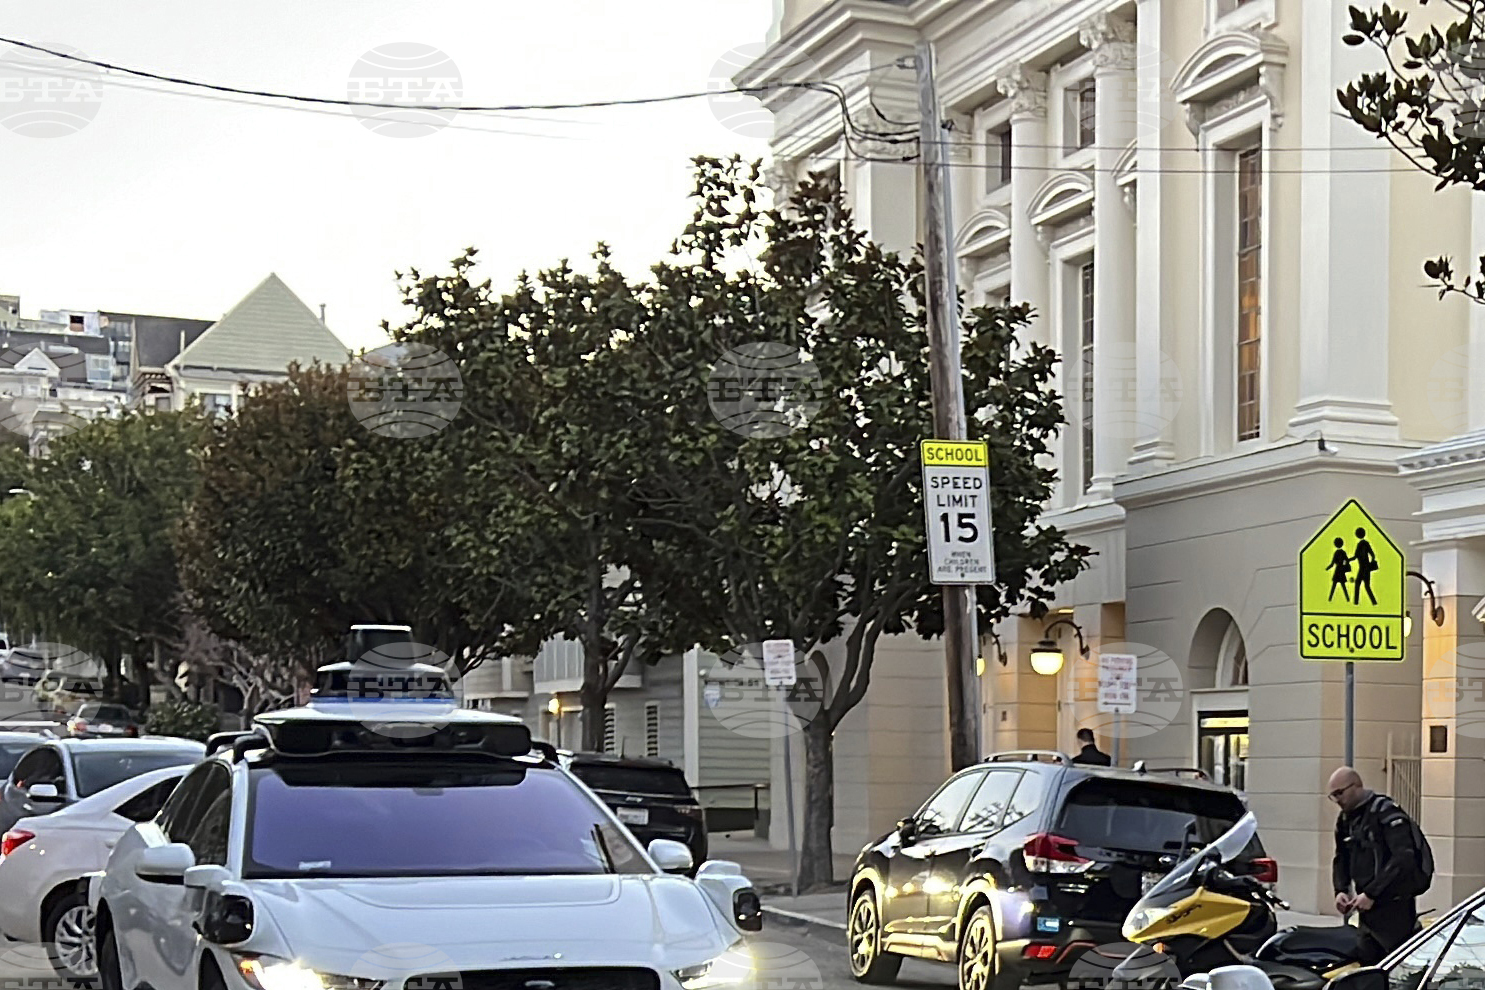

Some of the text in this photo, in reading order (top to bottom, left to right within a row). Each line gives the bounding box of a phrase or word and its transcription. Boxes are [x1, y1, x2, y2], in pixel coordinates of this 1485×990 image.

[926, 447, 983, 462] SCHOOL
[930, 476, 983, 490] SPEED
[936, 494, 978, 508] LIMIT
[940, 512, 978, 543] 15
[1307, 623, 1398, 650] SCHOOL
